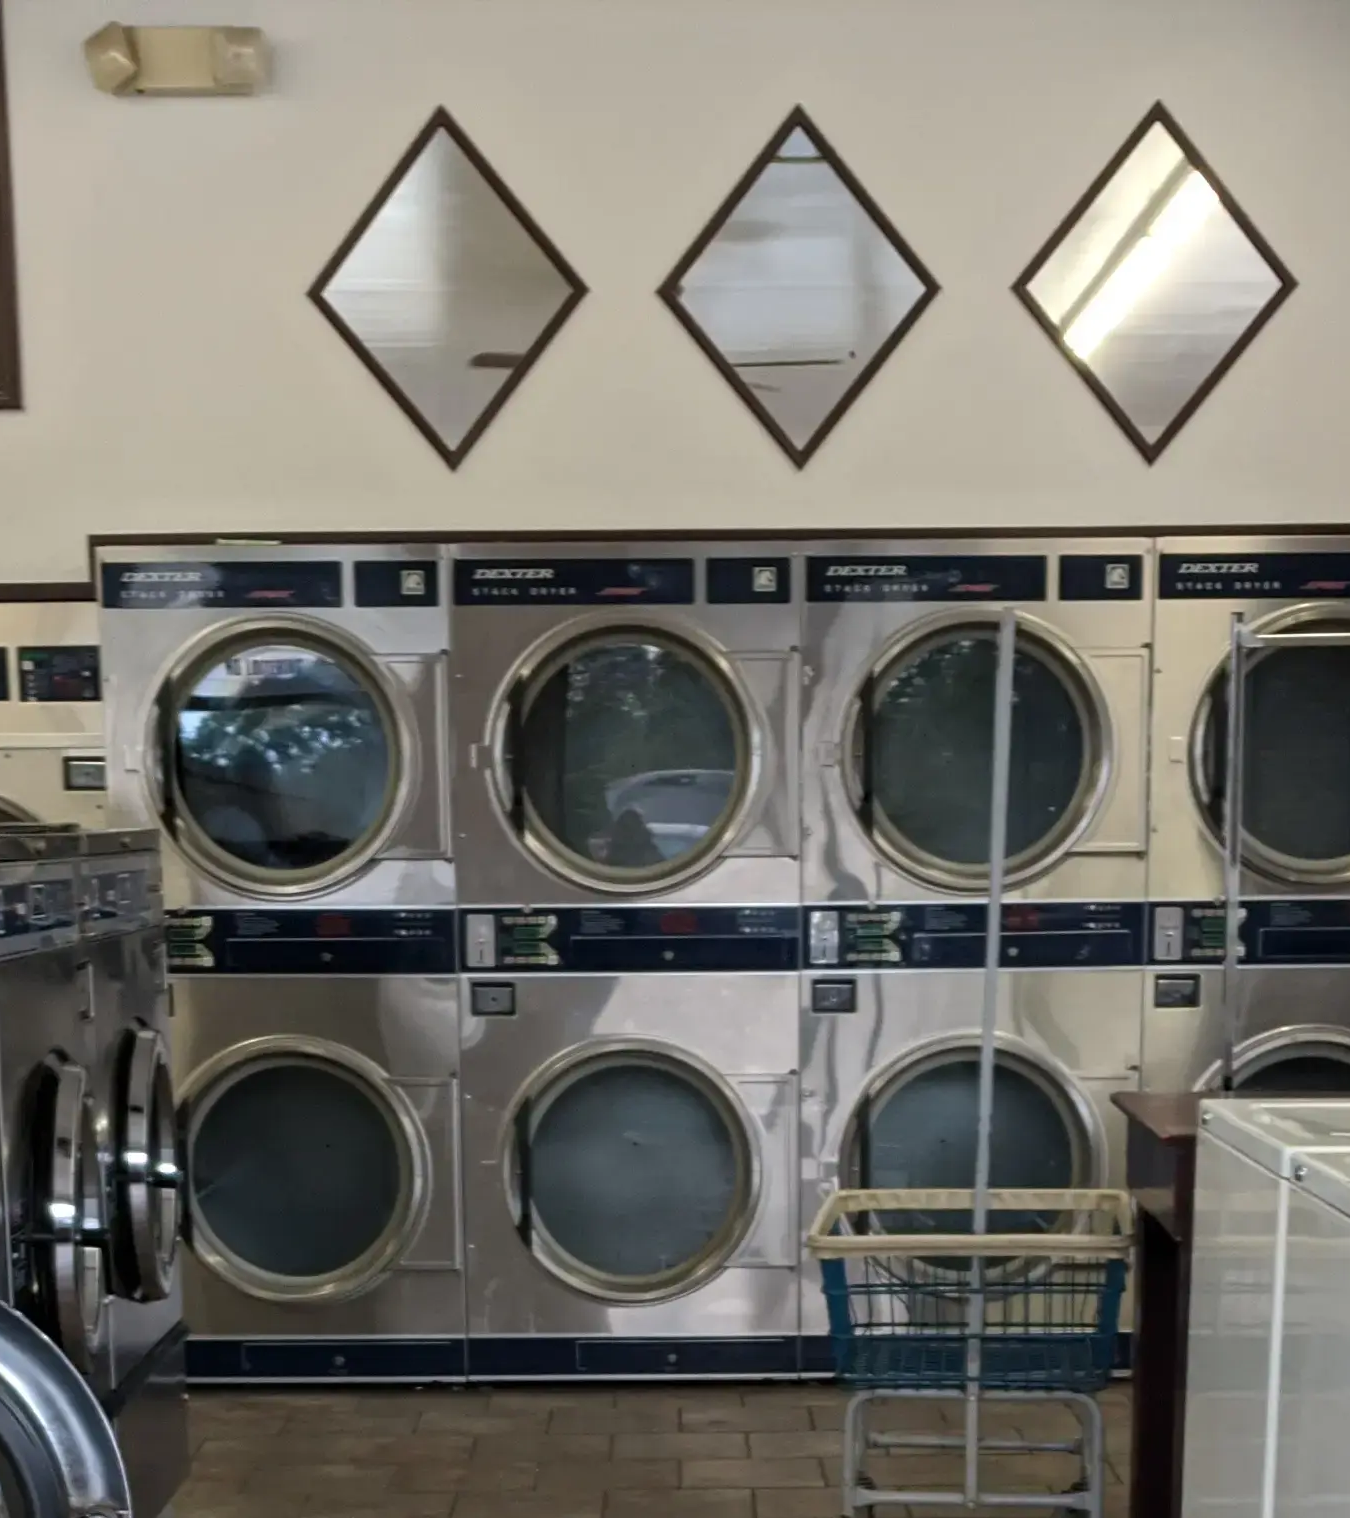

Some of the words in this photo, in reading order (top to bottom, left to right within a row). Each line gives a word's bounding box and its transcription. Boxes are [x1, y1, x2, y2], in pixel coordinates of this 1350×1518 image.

[471, 568, 555, 579] DEXTER
[825, 565, 907, 576] DEXTER
[1177, 562, 1259, 574] DEXTER
[119, 572, 203, 582] DEXTER
